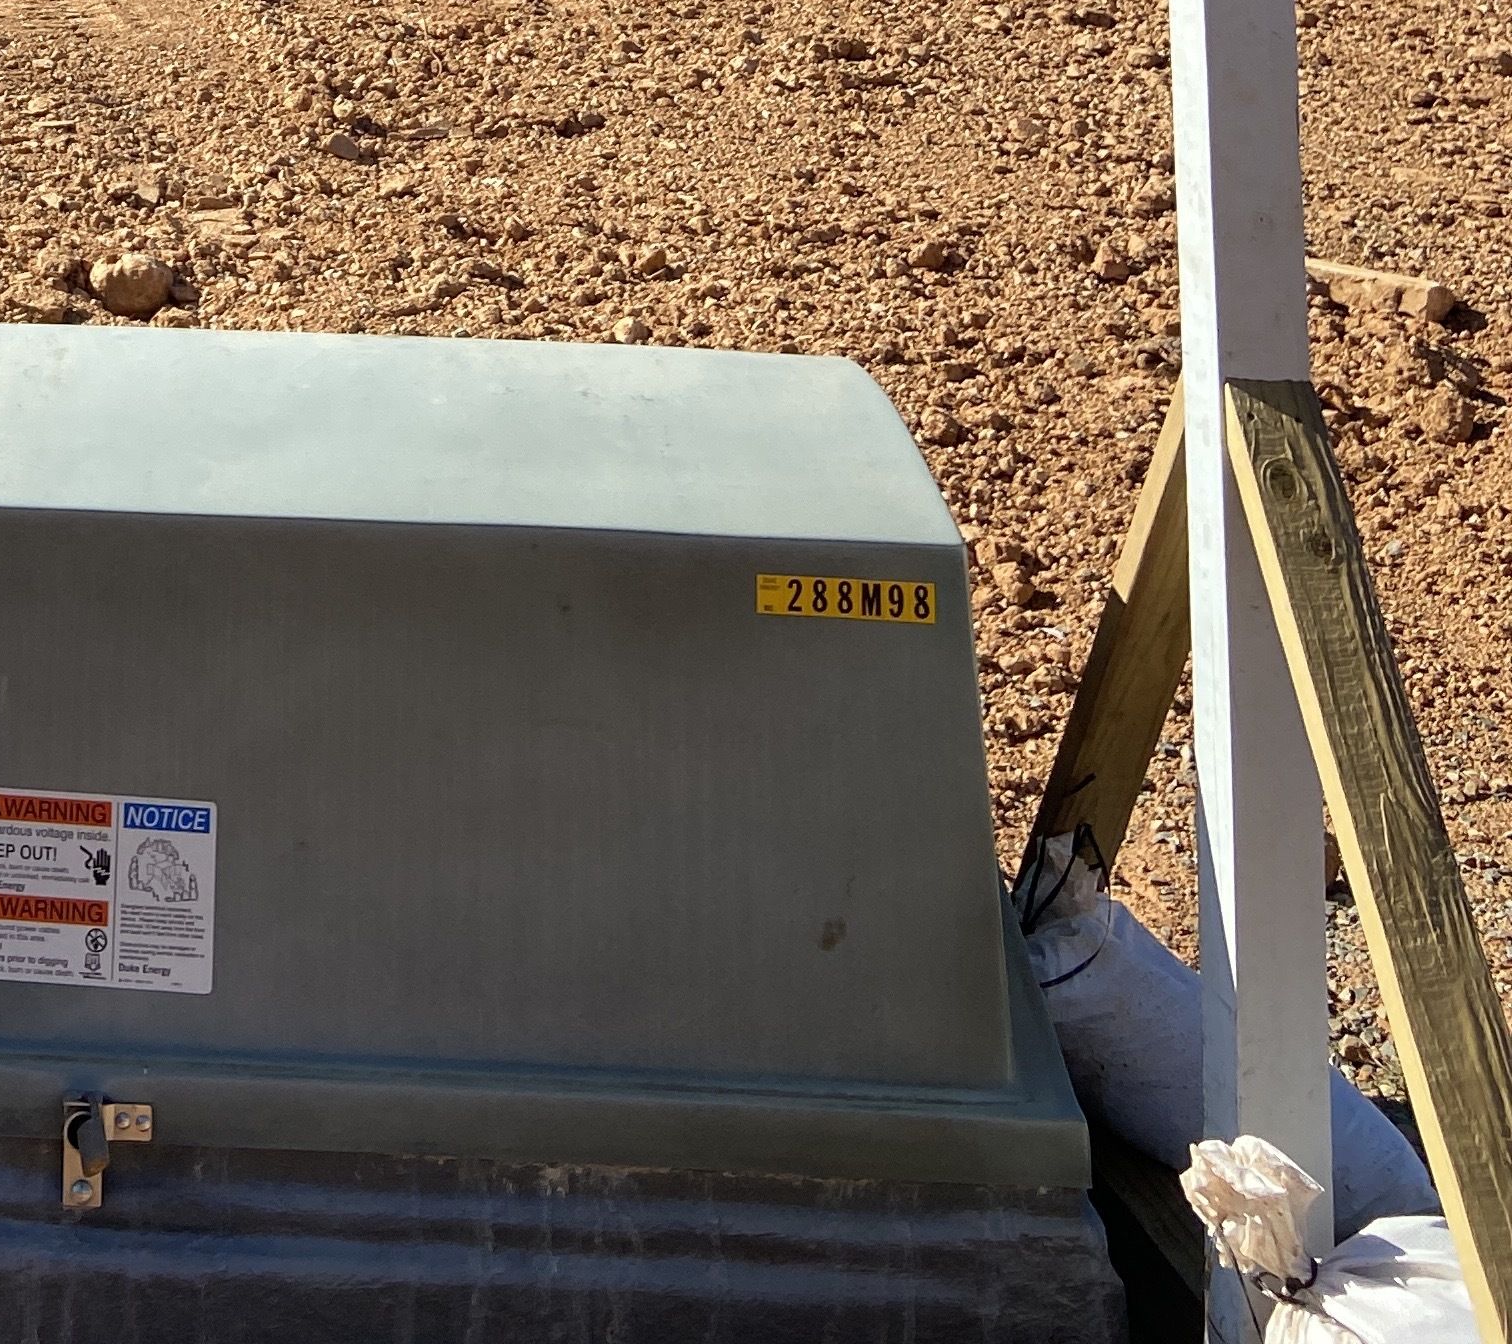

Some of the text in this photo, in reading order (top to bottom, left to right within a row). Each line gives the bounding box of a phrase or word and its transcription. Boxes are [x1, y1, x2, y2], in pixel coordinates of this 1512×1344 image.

[787, 579, 930, 618] 288M98
[4, 798, 107, 823] WARNING
[126, 807, 208, 830] NOTICE
[19, 844, 57, 860] OUT!
[0, 897, 104, 923] WARNING
[118, 962, 171, 976] Duke Energy
